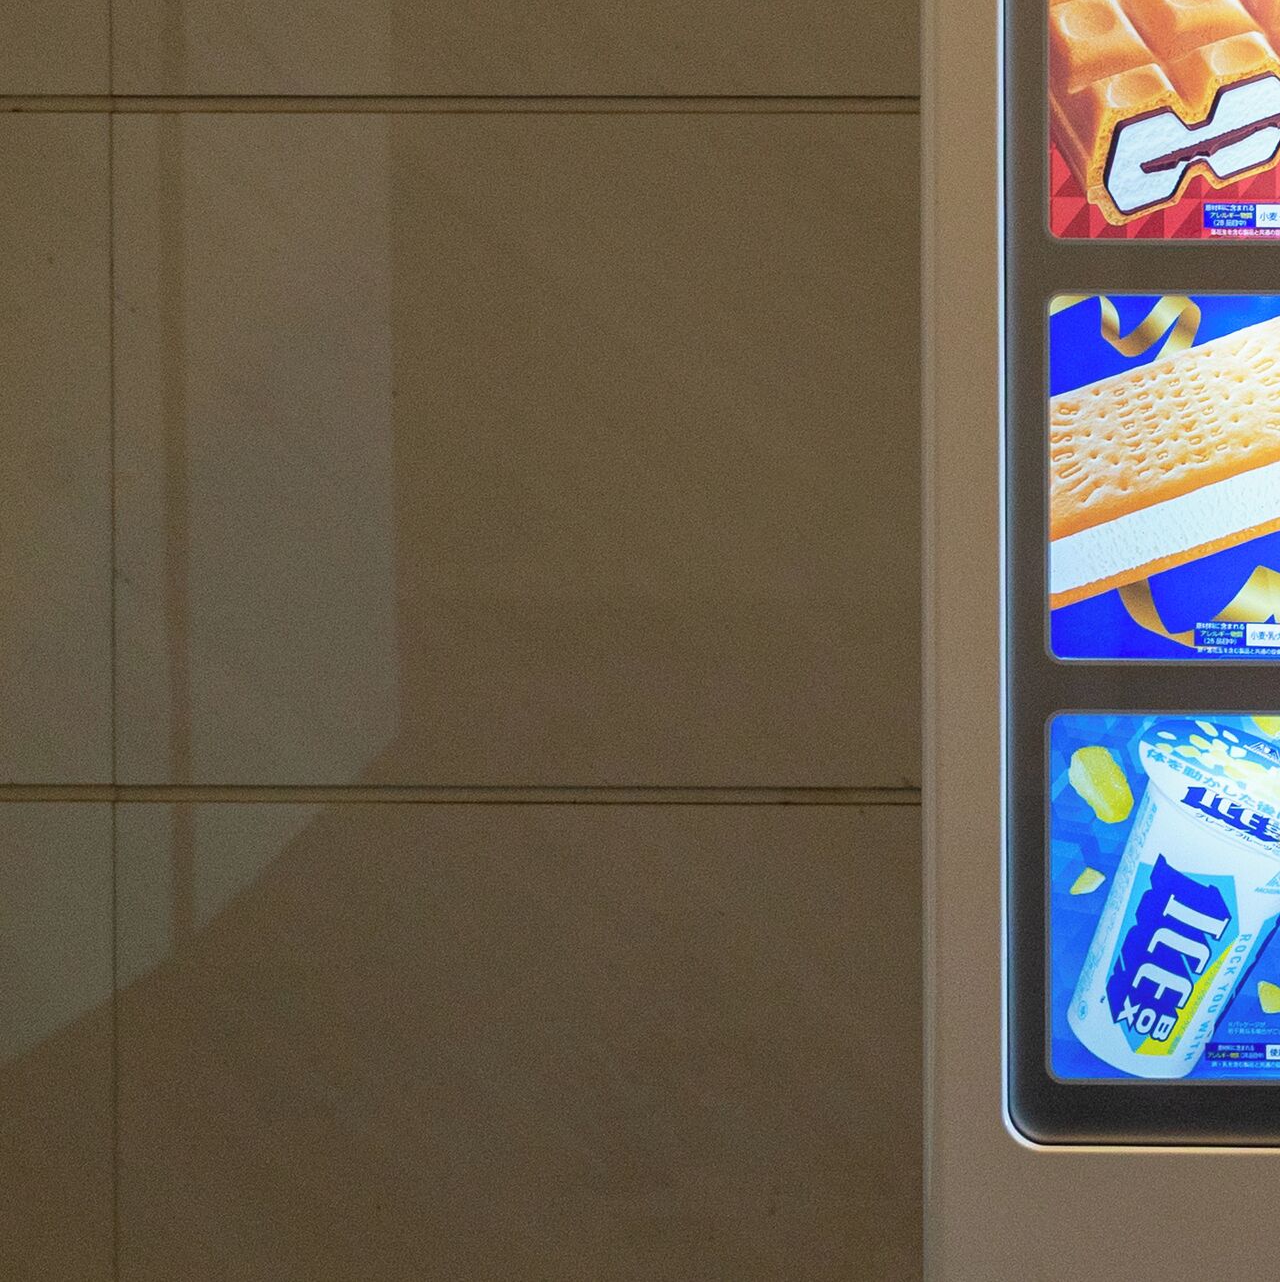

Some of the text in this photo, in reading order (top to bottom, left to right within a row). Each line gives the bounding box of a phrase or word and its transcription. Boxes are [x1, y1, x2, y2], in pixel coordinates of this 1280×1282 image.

[1132, 894, 1230, 1009] ICE
[1224, 933, 1253, 975] ROCK
[1117, 995, 1178, 1041] BOX
[1208, 986, 1227, 1013] YOU
